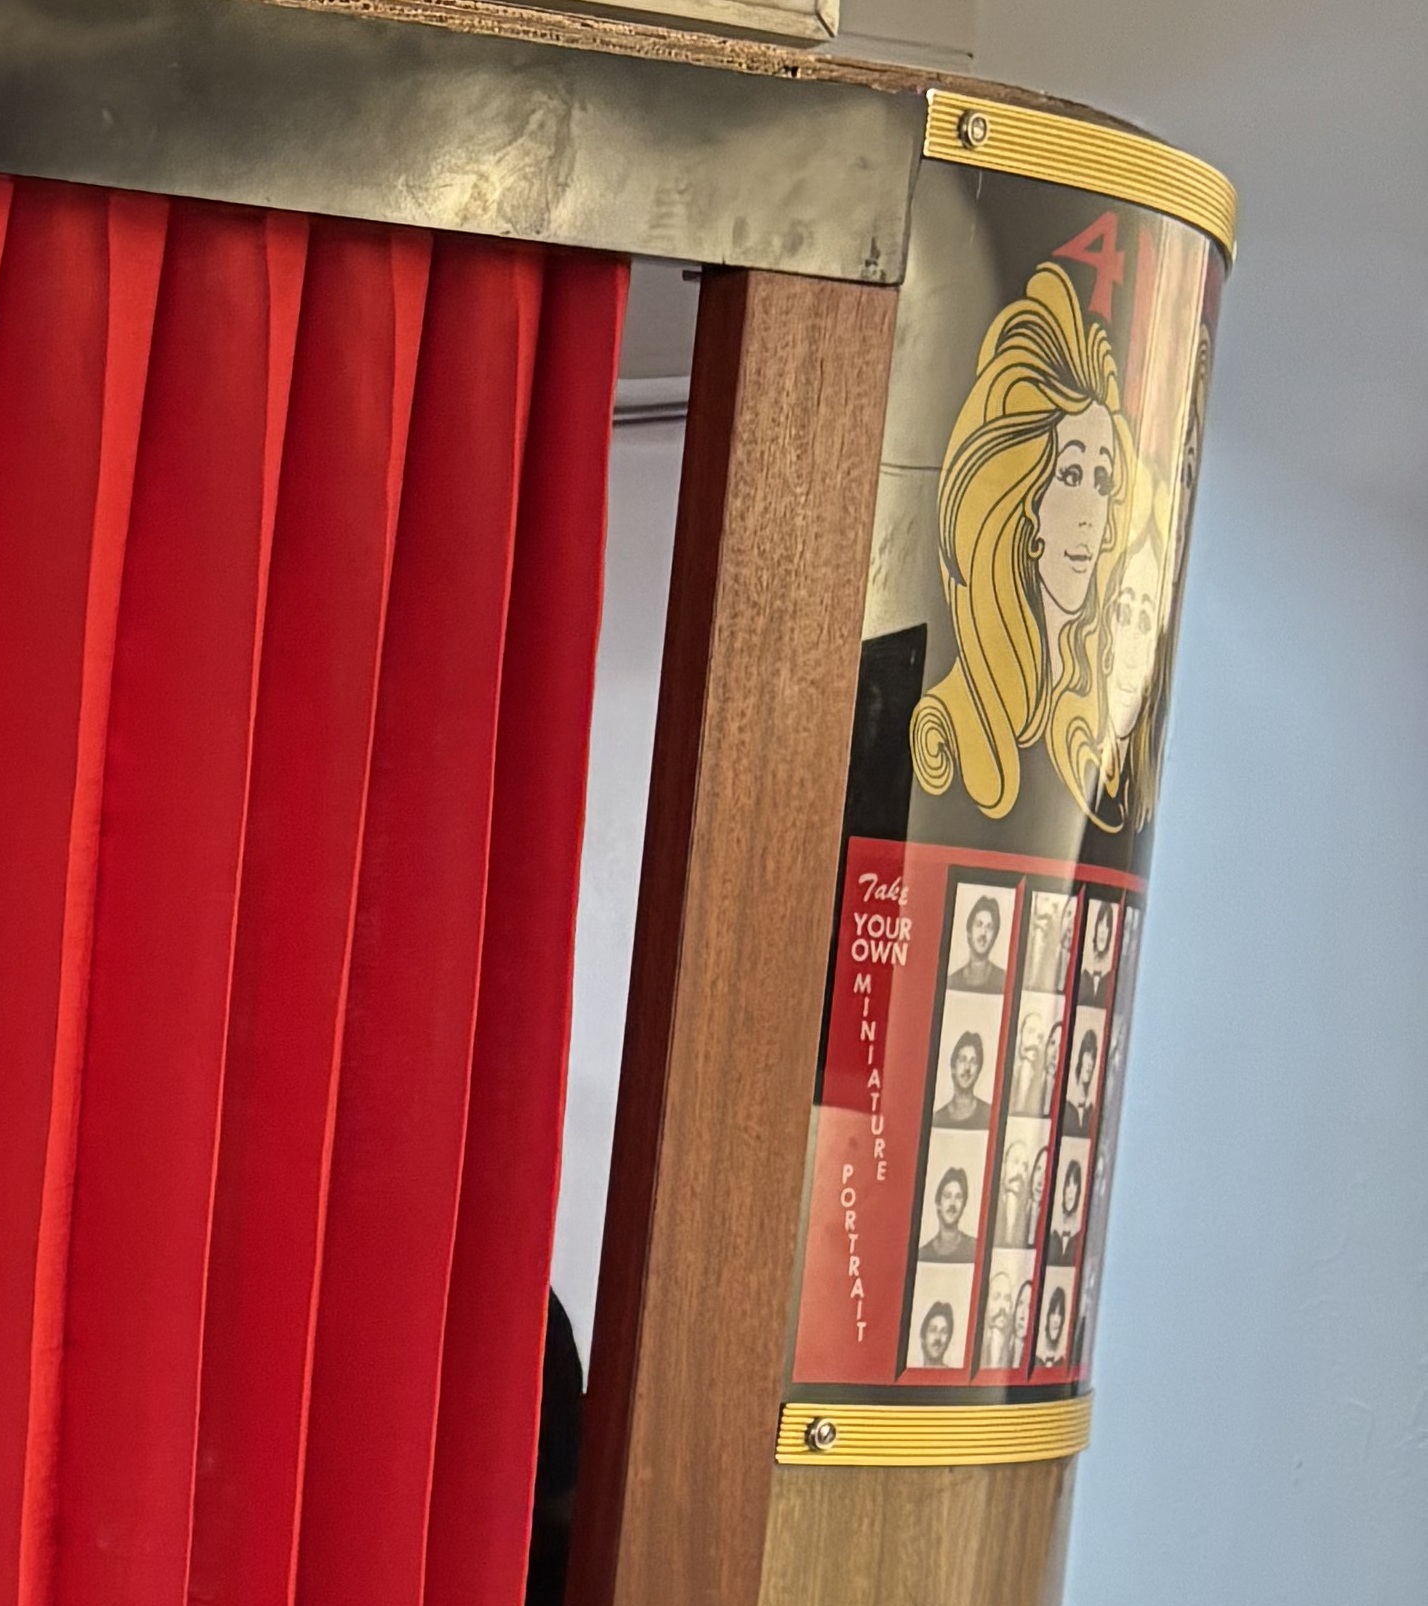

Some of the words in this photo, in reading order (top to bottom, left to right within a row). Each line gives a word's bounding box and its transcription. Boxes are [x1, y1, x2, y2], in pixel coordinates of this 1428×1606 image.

[1052, 211, 1126, 321] 4
[858, 873, 909, 905] Take
[851, 938, 908, 966] OWN
[853, 912, 912, 941] YOUR
[853, 973, 887, 1181] MINIATURE
[840, 1164, 867, 1342] PORTRAIT
